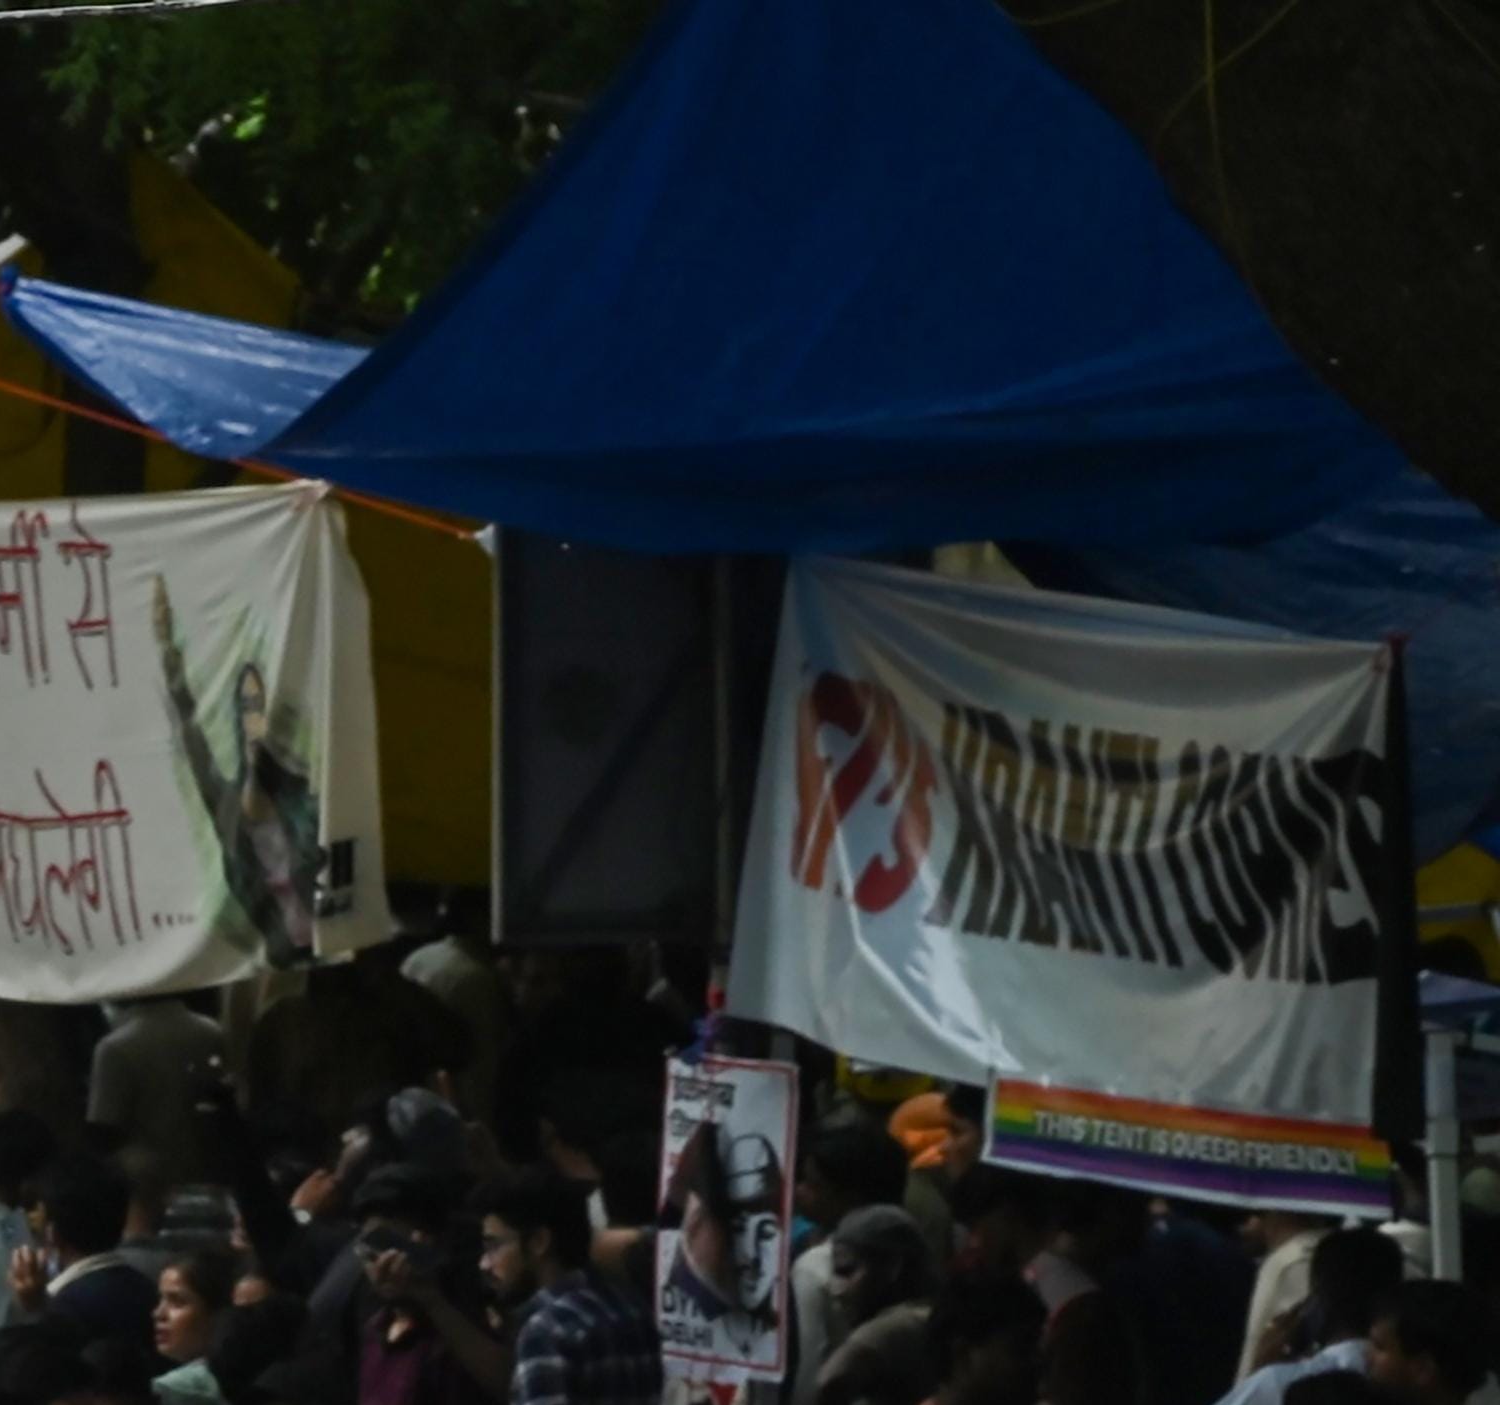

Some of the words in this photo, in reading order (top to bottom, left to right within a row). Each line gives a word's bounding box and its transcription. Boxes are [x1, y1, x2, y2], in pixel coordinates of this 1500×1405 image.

[56, 501, 119, 691] से
[1034, 1110, 1087, 1142] THIS
[1090, 1119, 1150, 1150] TENT
[1150, 1129, 1170, 1154] IS
[1171, 1132, 1243, 1162] QUEER
[1243, 1142, 1357, 1174] FRIENDLY
